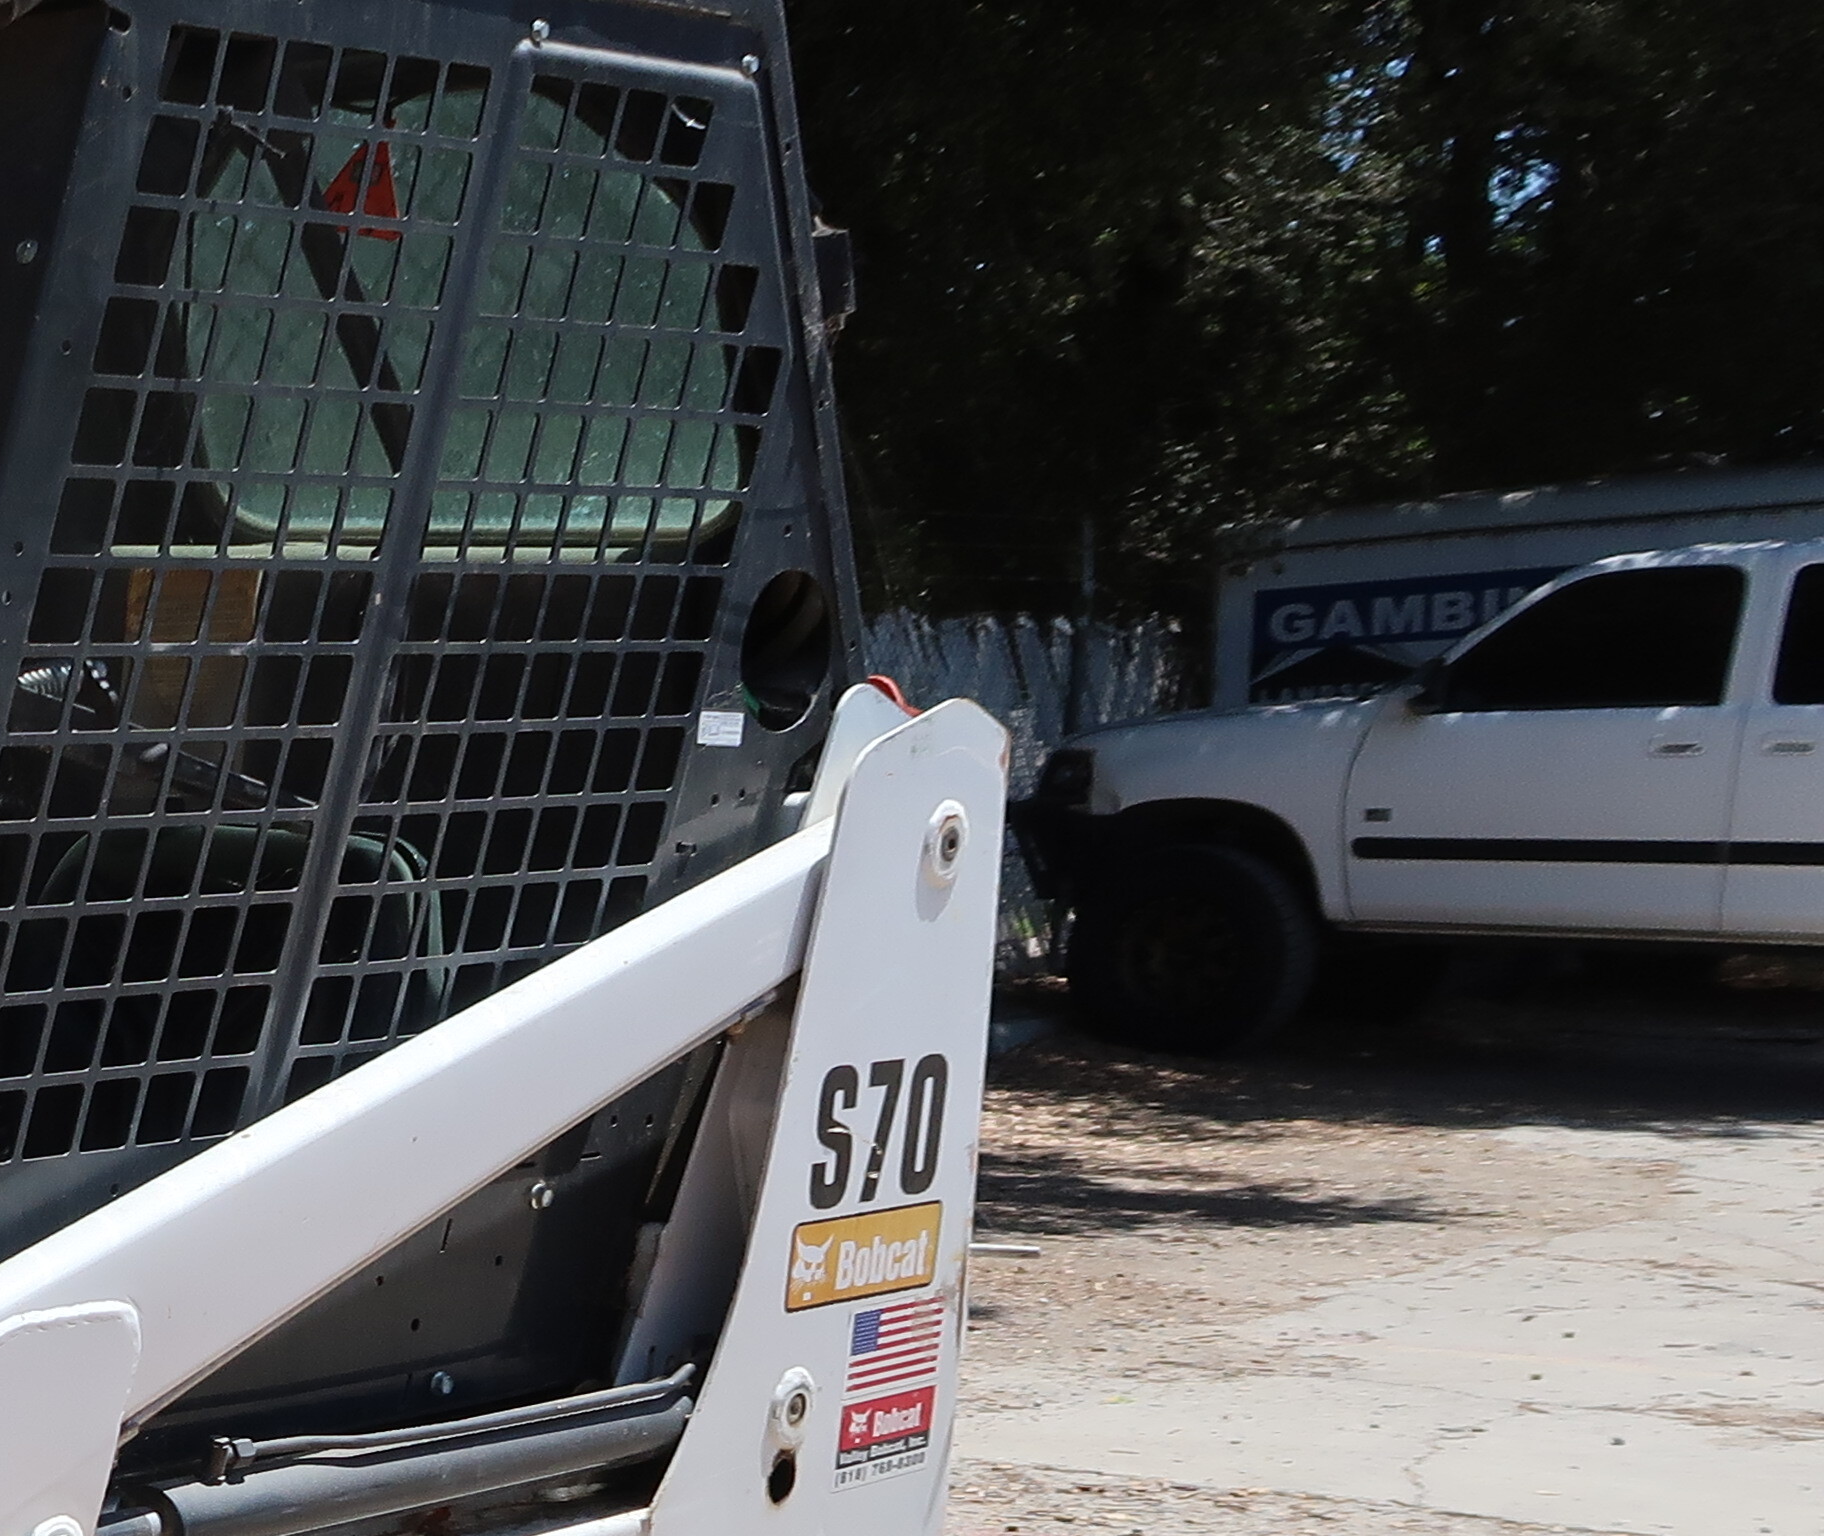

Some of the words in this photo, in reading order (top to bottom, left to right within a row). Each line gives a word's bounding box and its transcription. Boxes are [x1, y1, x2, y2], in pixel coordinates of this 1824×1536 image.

[809, 1053, 948, 1210] S70
[834, 1229, 930, 1291] Bobcat
[872, 1402, 924, 1437] Bobcat
